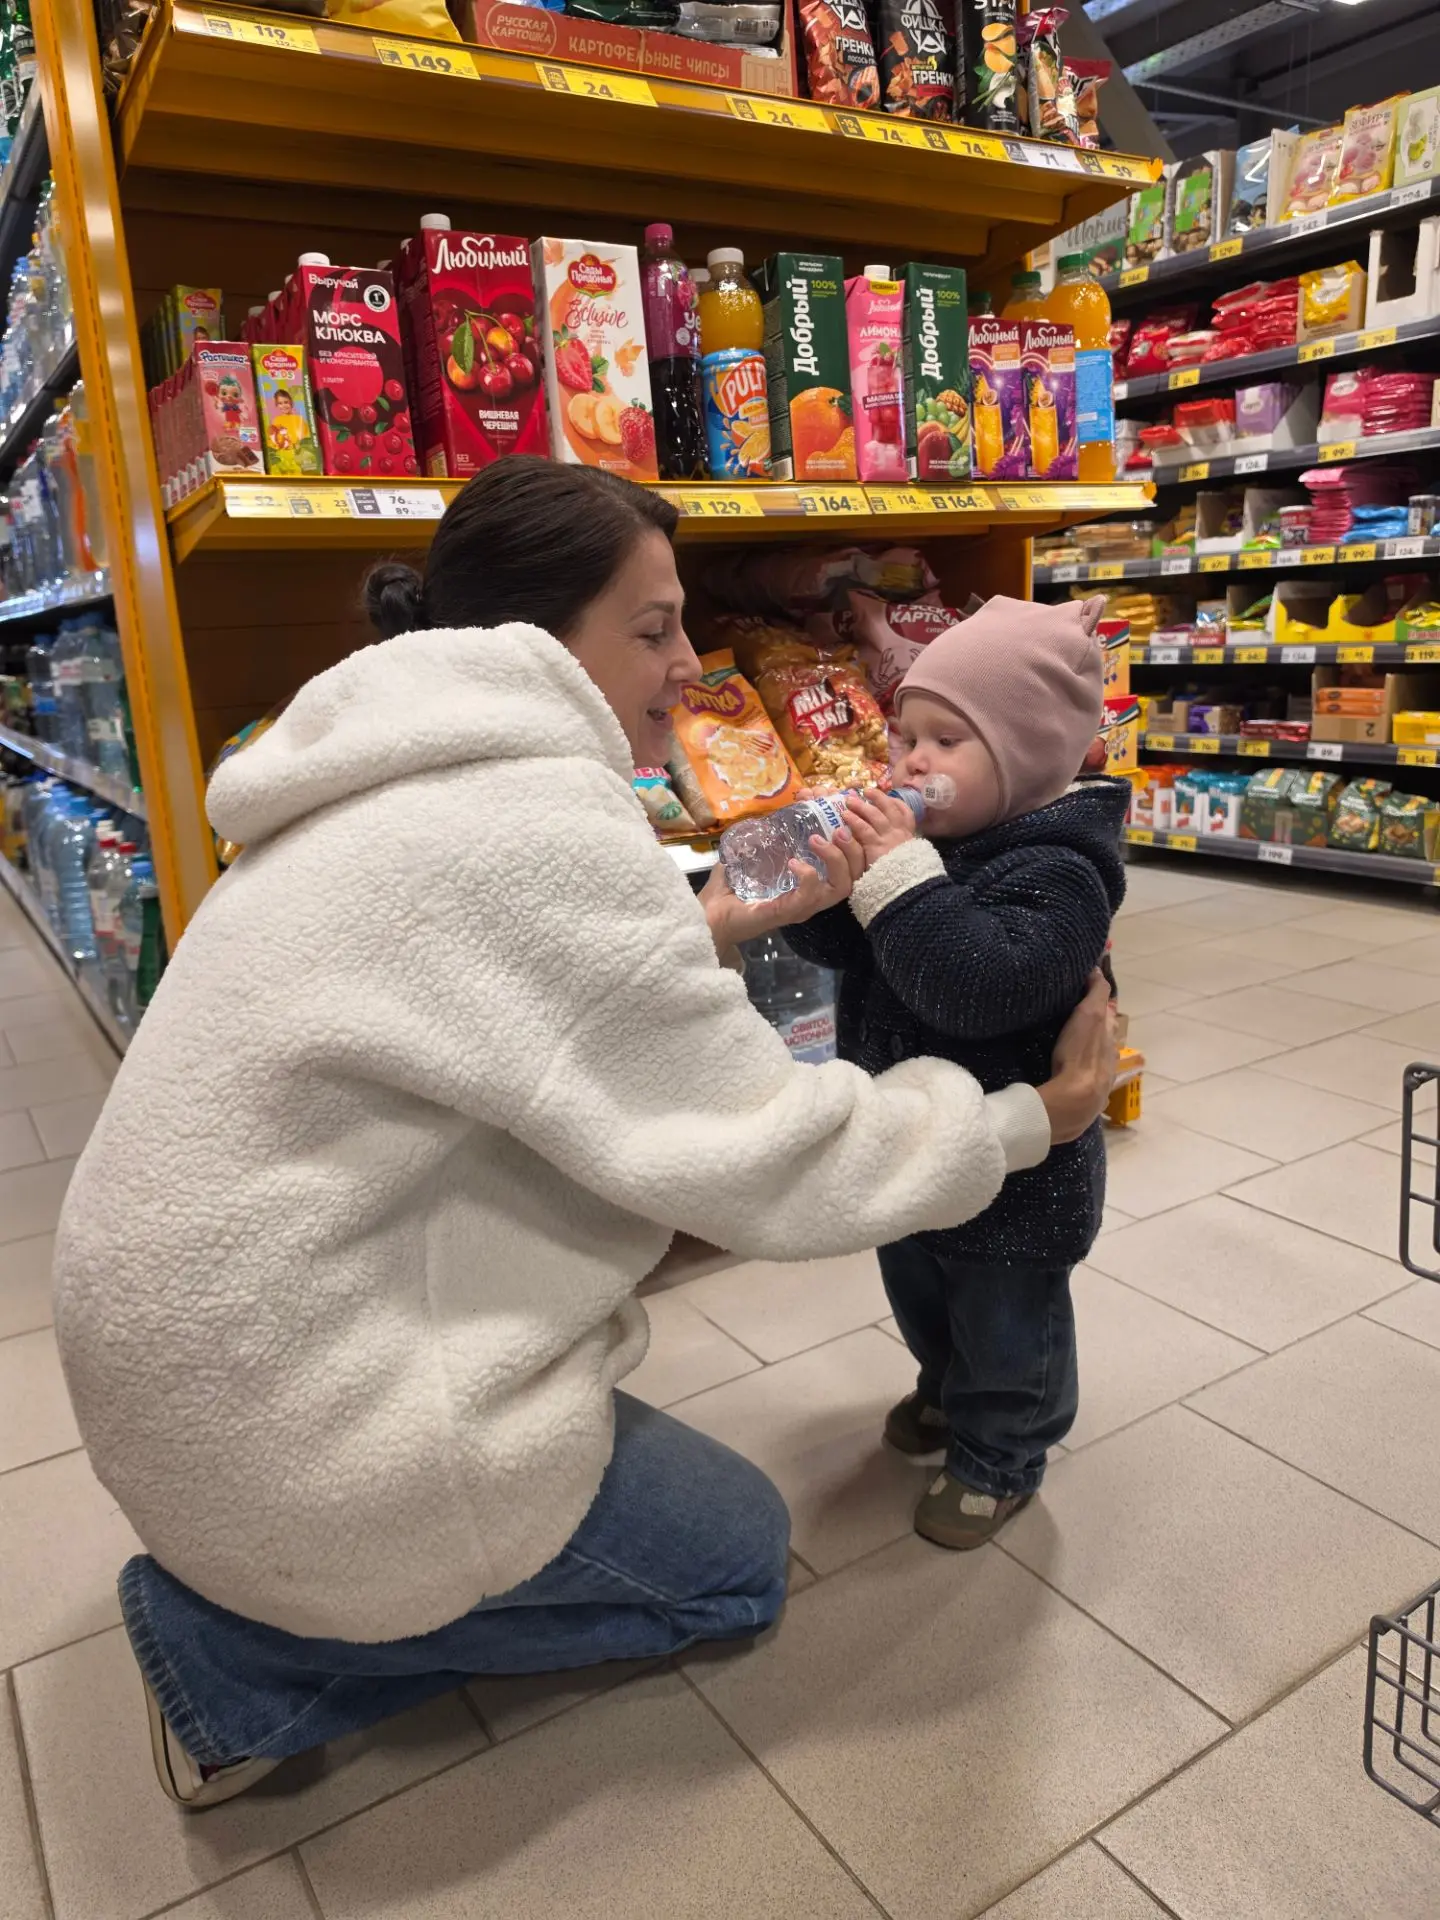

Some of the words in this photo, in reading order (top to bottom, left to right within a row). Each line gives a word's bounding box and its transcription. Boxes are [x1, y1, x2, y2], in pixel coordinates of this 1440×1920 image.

[497, 14, 548, 31] РУССКАЯ
[900, 14, 948, 35] ФИШКА
[254, 24, 286, 40] 119
[492, 27, 552, 44] КАРТОШКА
[407, 52, 452, 72] 149
[569, 36, 682, 70] КАРТОФЕЛЬНЫЕ
[686, 57, 731, 79] ЧИПСЫ
[583, 81, 614, 98] 24
[767, 111, 794, 127] 24
[877, 127, 903, 143] 74
[960, 140, 986, 157] 74
[431, 236, 529, 275] Любимый
[308, 273, 359, 289] Выручай
[811, 280, 837, 290] 100%
[313, 309, 362, 327] МОРС
[315, 326, 386, 345] КЛЮКВА
[786, 277, 820, 377] Добрый
[916, 286, 944, 381] Добрый
[968, 322, 1020, 348] Любимый
[1023, 326, 1074, 352] Любимый
[479, 409, 520, 420] ВИШНЕВАЯ
[708, 500, 741, 514] 129
[818, 495, 852, 511] 164
[948, 495, 978, 509] 164
